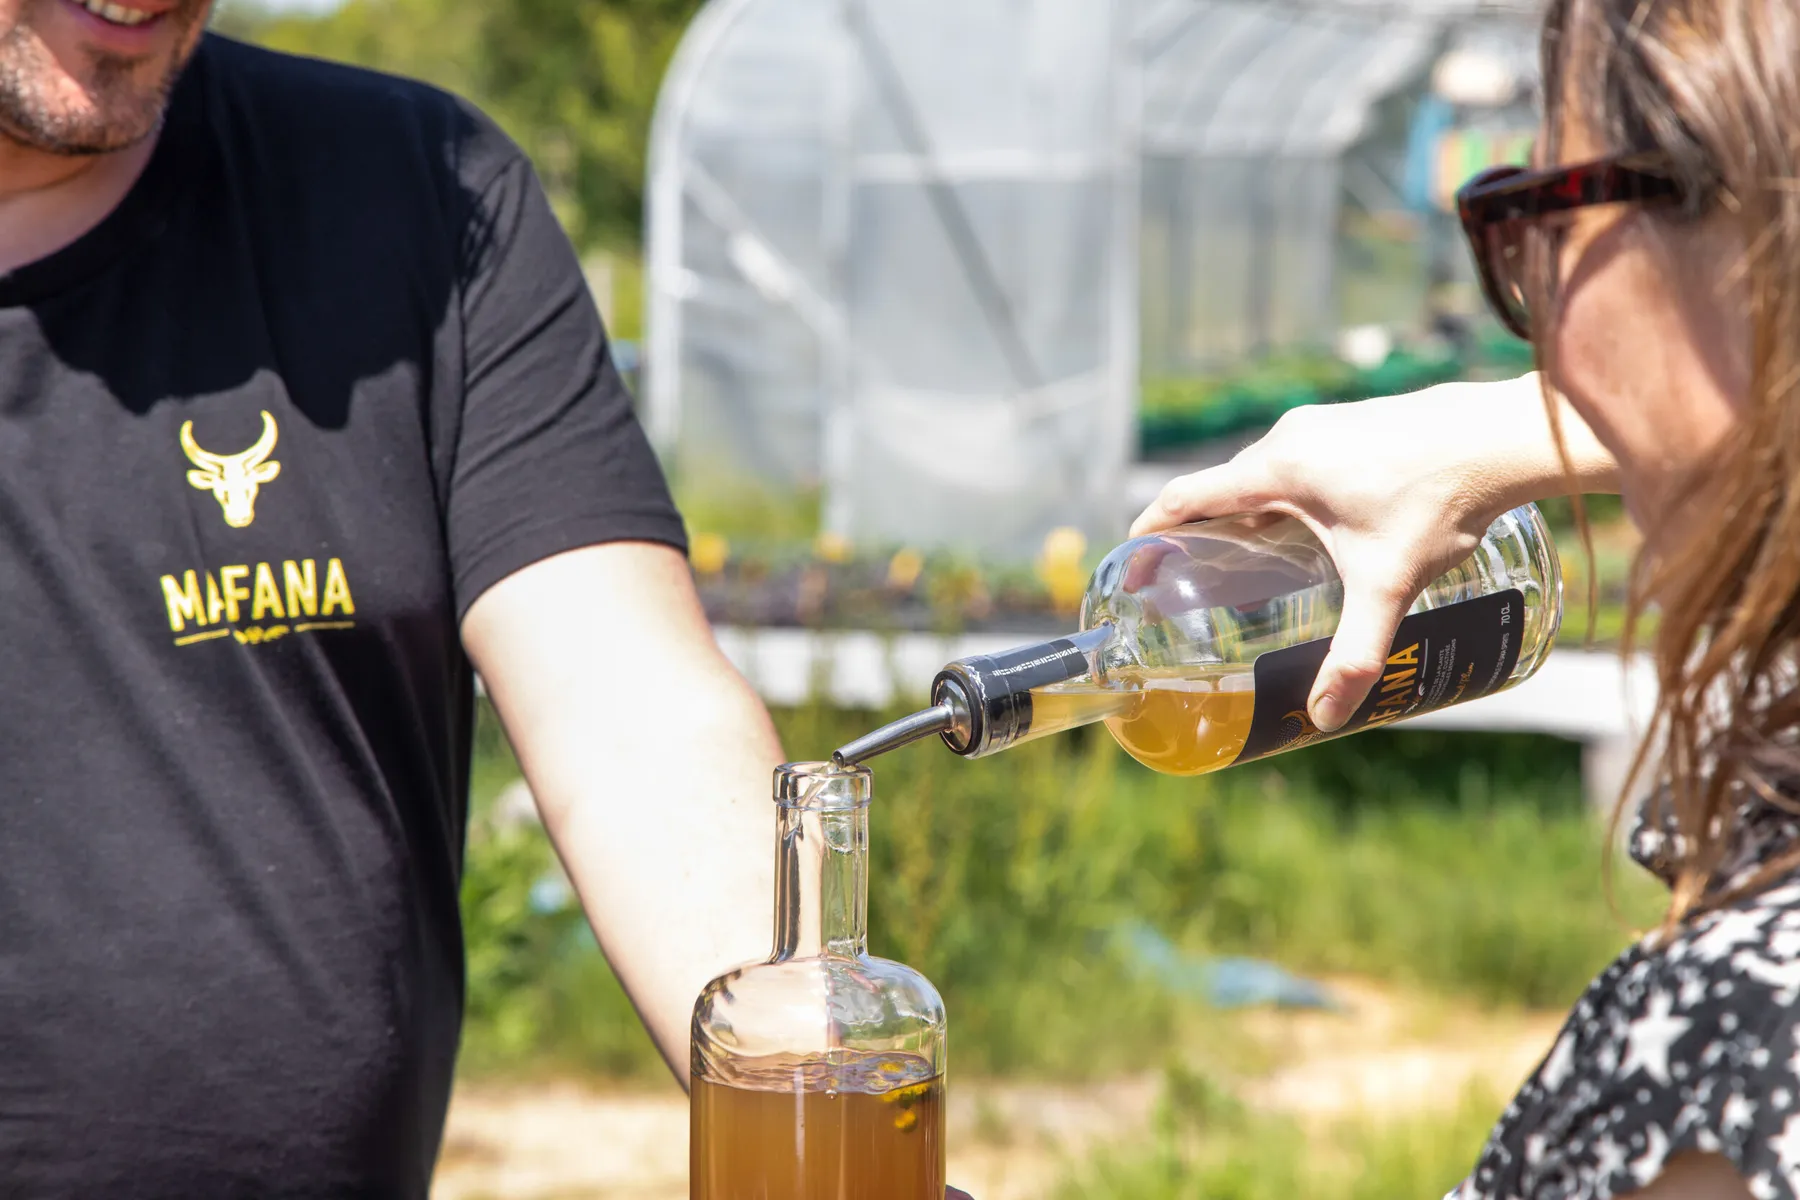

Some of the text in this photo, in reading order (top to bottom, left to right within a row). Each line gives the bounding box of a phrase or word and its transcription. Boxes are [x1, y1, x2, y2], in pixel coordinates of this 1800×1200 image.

[160, 558, 355, 632] MAFANA
[1501, 614, 1511, 626] 70
[1360, 642, 1419, 730] FANA
